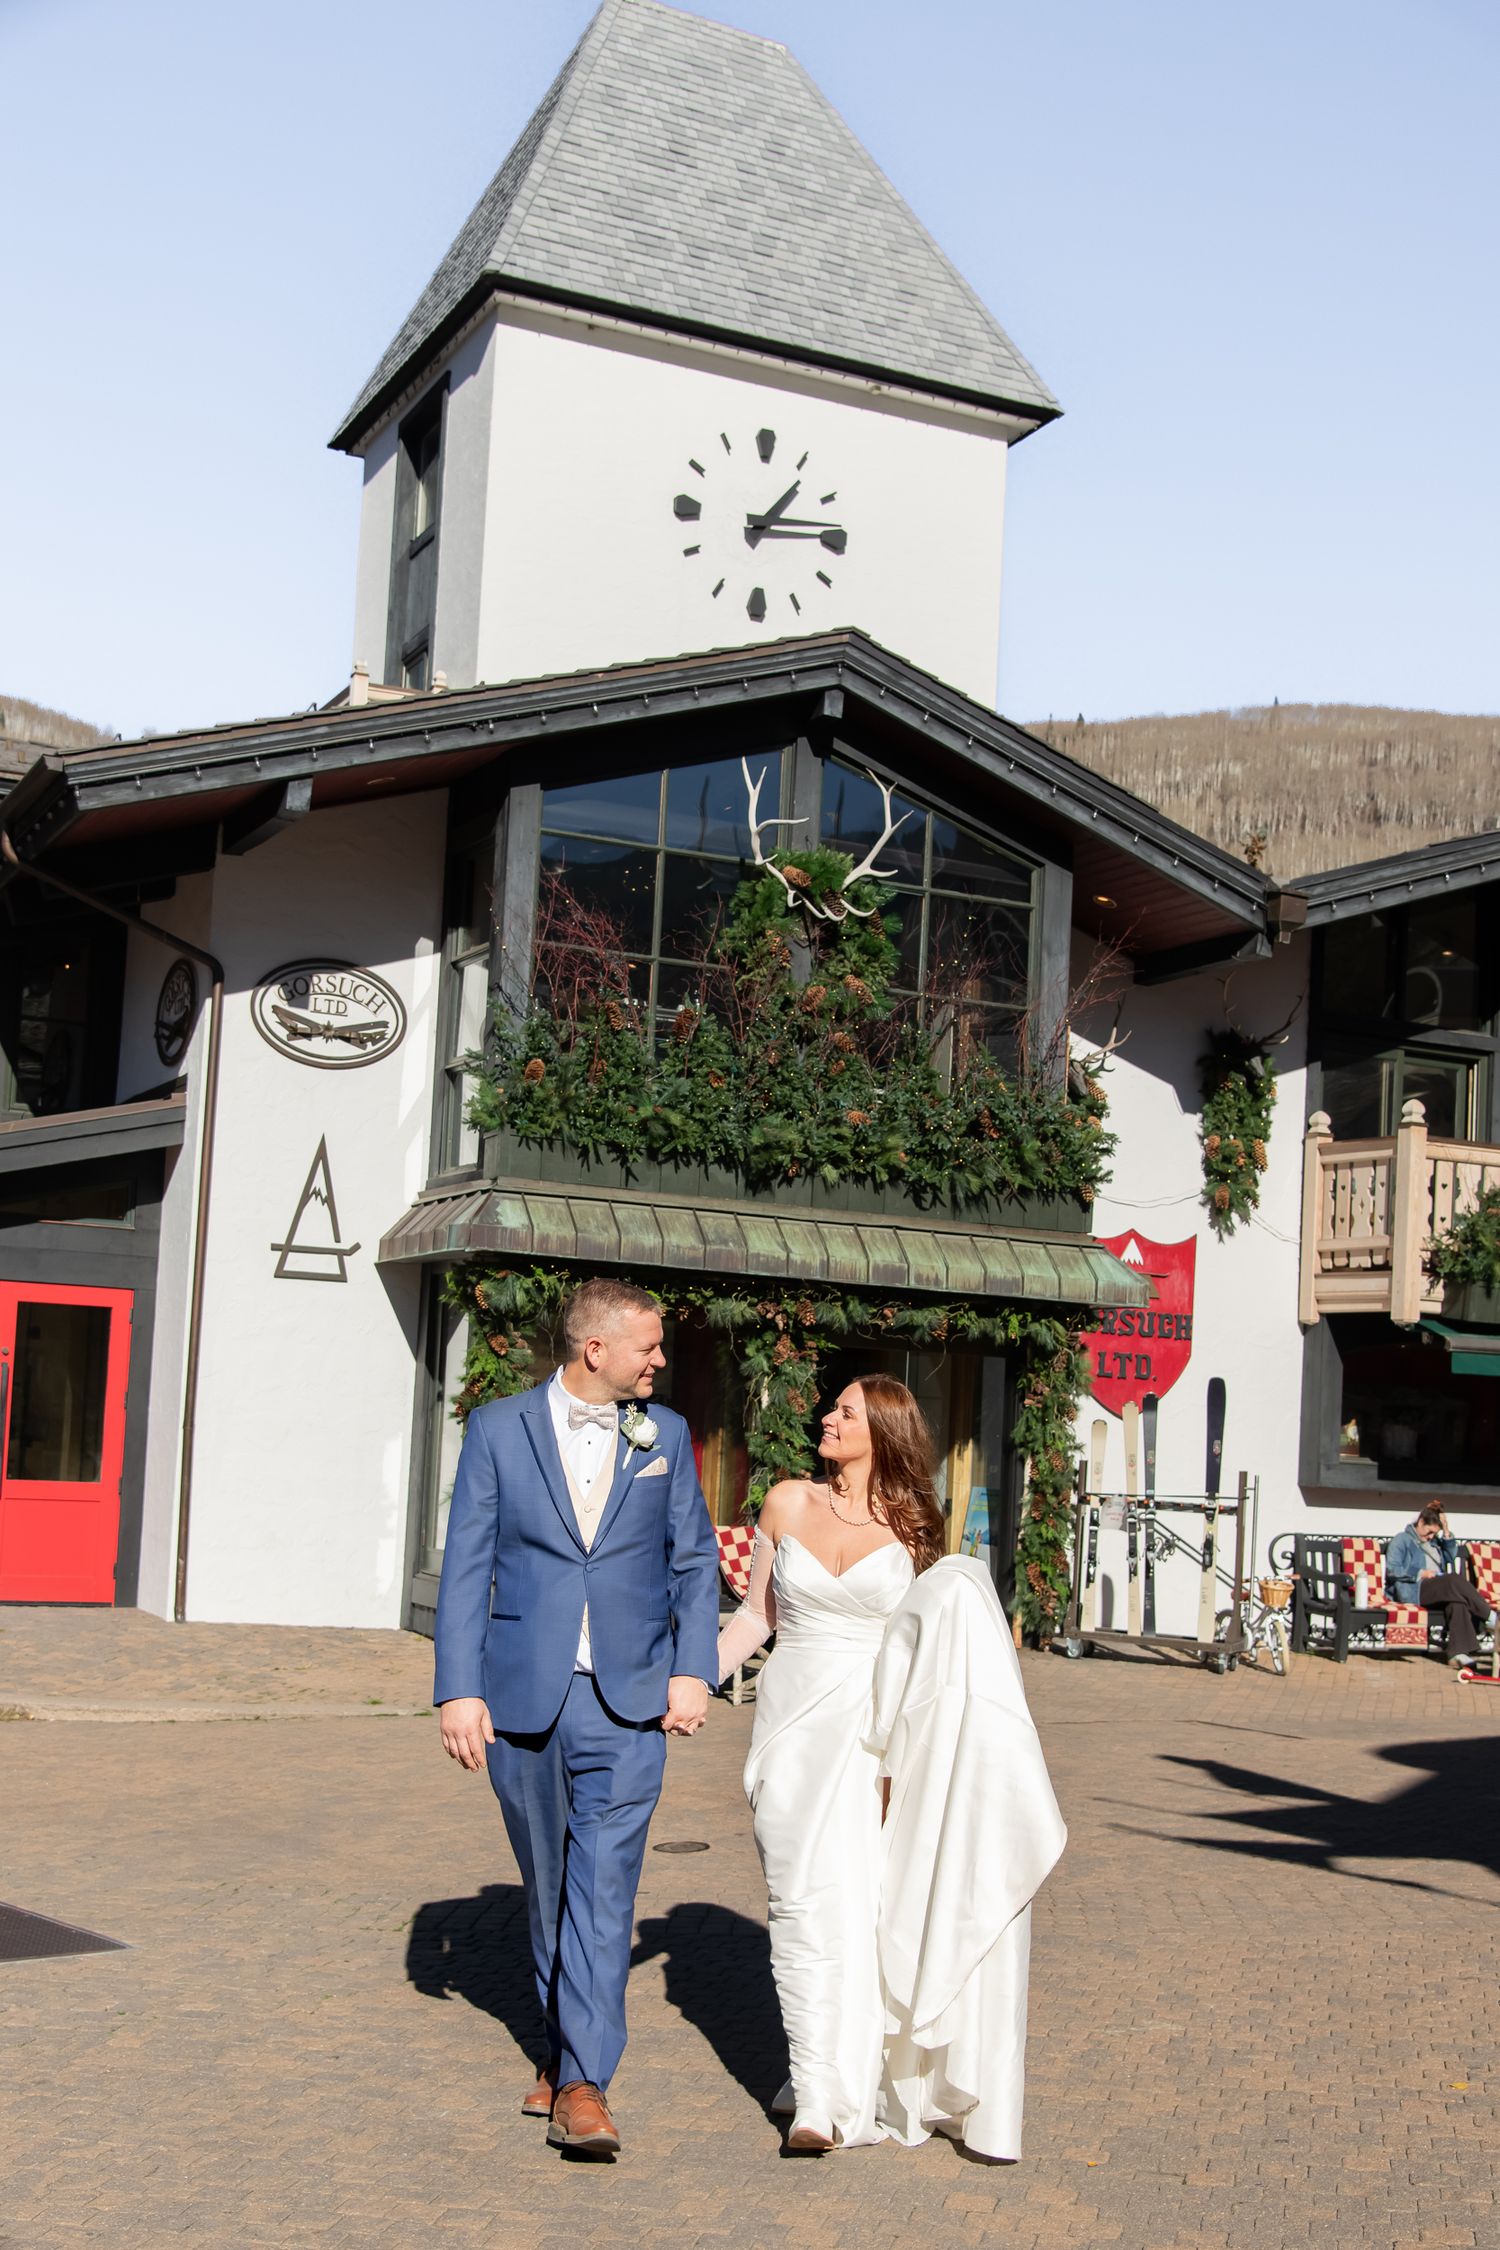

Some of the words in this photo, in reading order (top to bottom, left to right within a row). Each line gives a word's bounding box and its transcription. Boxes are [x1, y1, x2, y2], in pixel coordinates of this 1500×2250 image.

[277, 974, 387, 1015] GORSUCH
[312, 997, 348, 1015] LTD
[1092, 1308, 1192, 1341] RSUCH
[1096, 1351, 1158, 1382] LTD.
